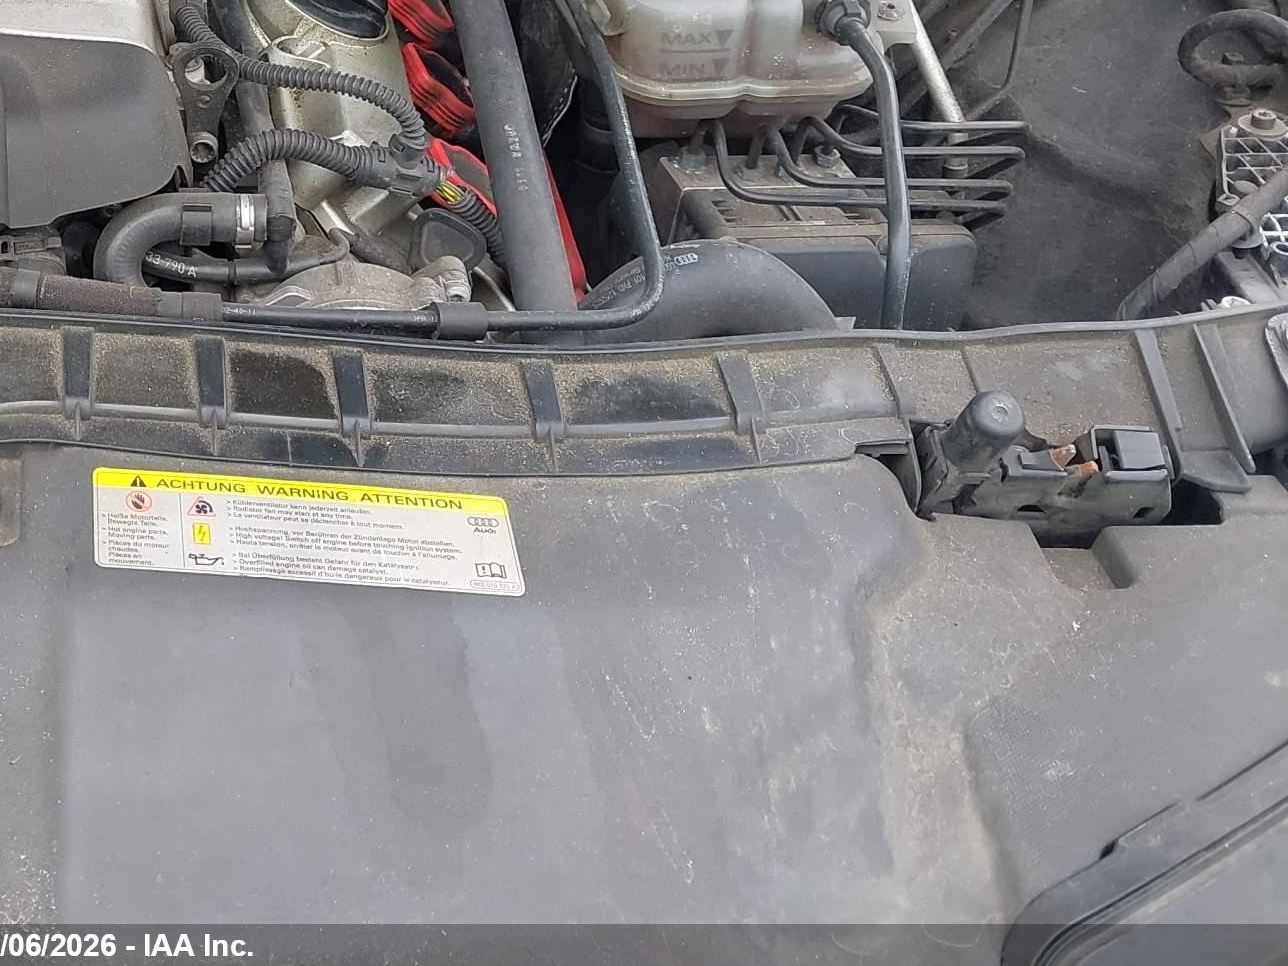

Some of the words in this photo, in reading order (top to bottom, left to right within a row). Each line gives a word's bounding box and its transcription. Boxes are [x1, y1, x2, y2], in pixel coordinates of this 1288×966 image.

[660, 32, 713, 45] MAX
[660, 64, 705, 75] MIN
[156, 479, 246, 493] ACHTUNG
[256, 485, 349, 501] WARNING
[360, 493, 463, 510] ATTENTION
[108, 532, 135, 540] Moving
